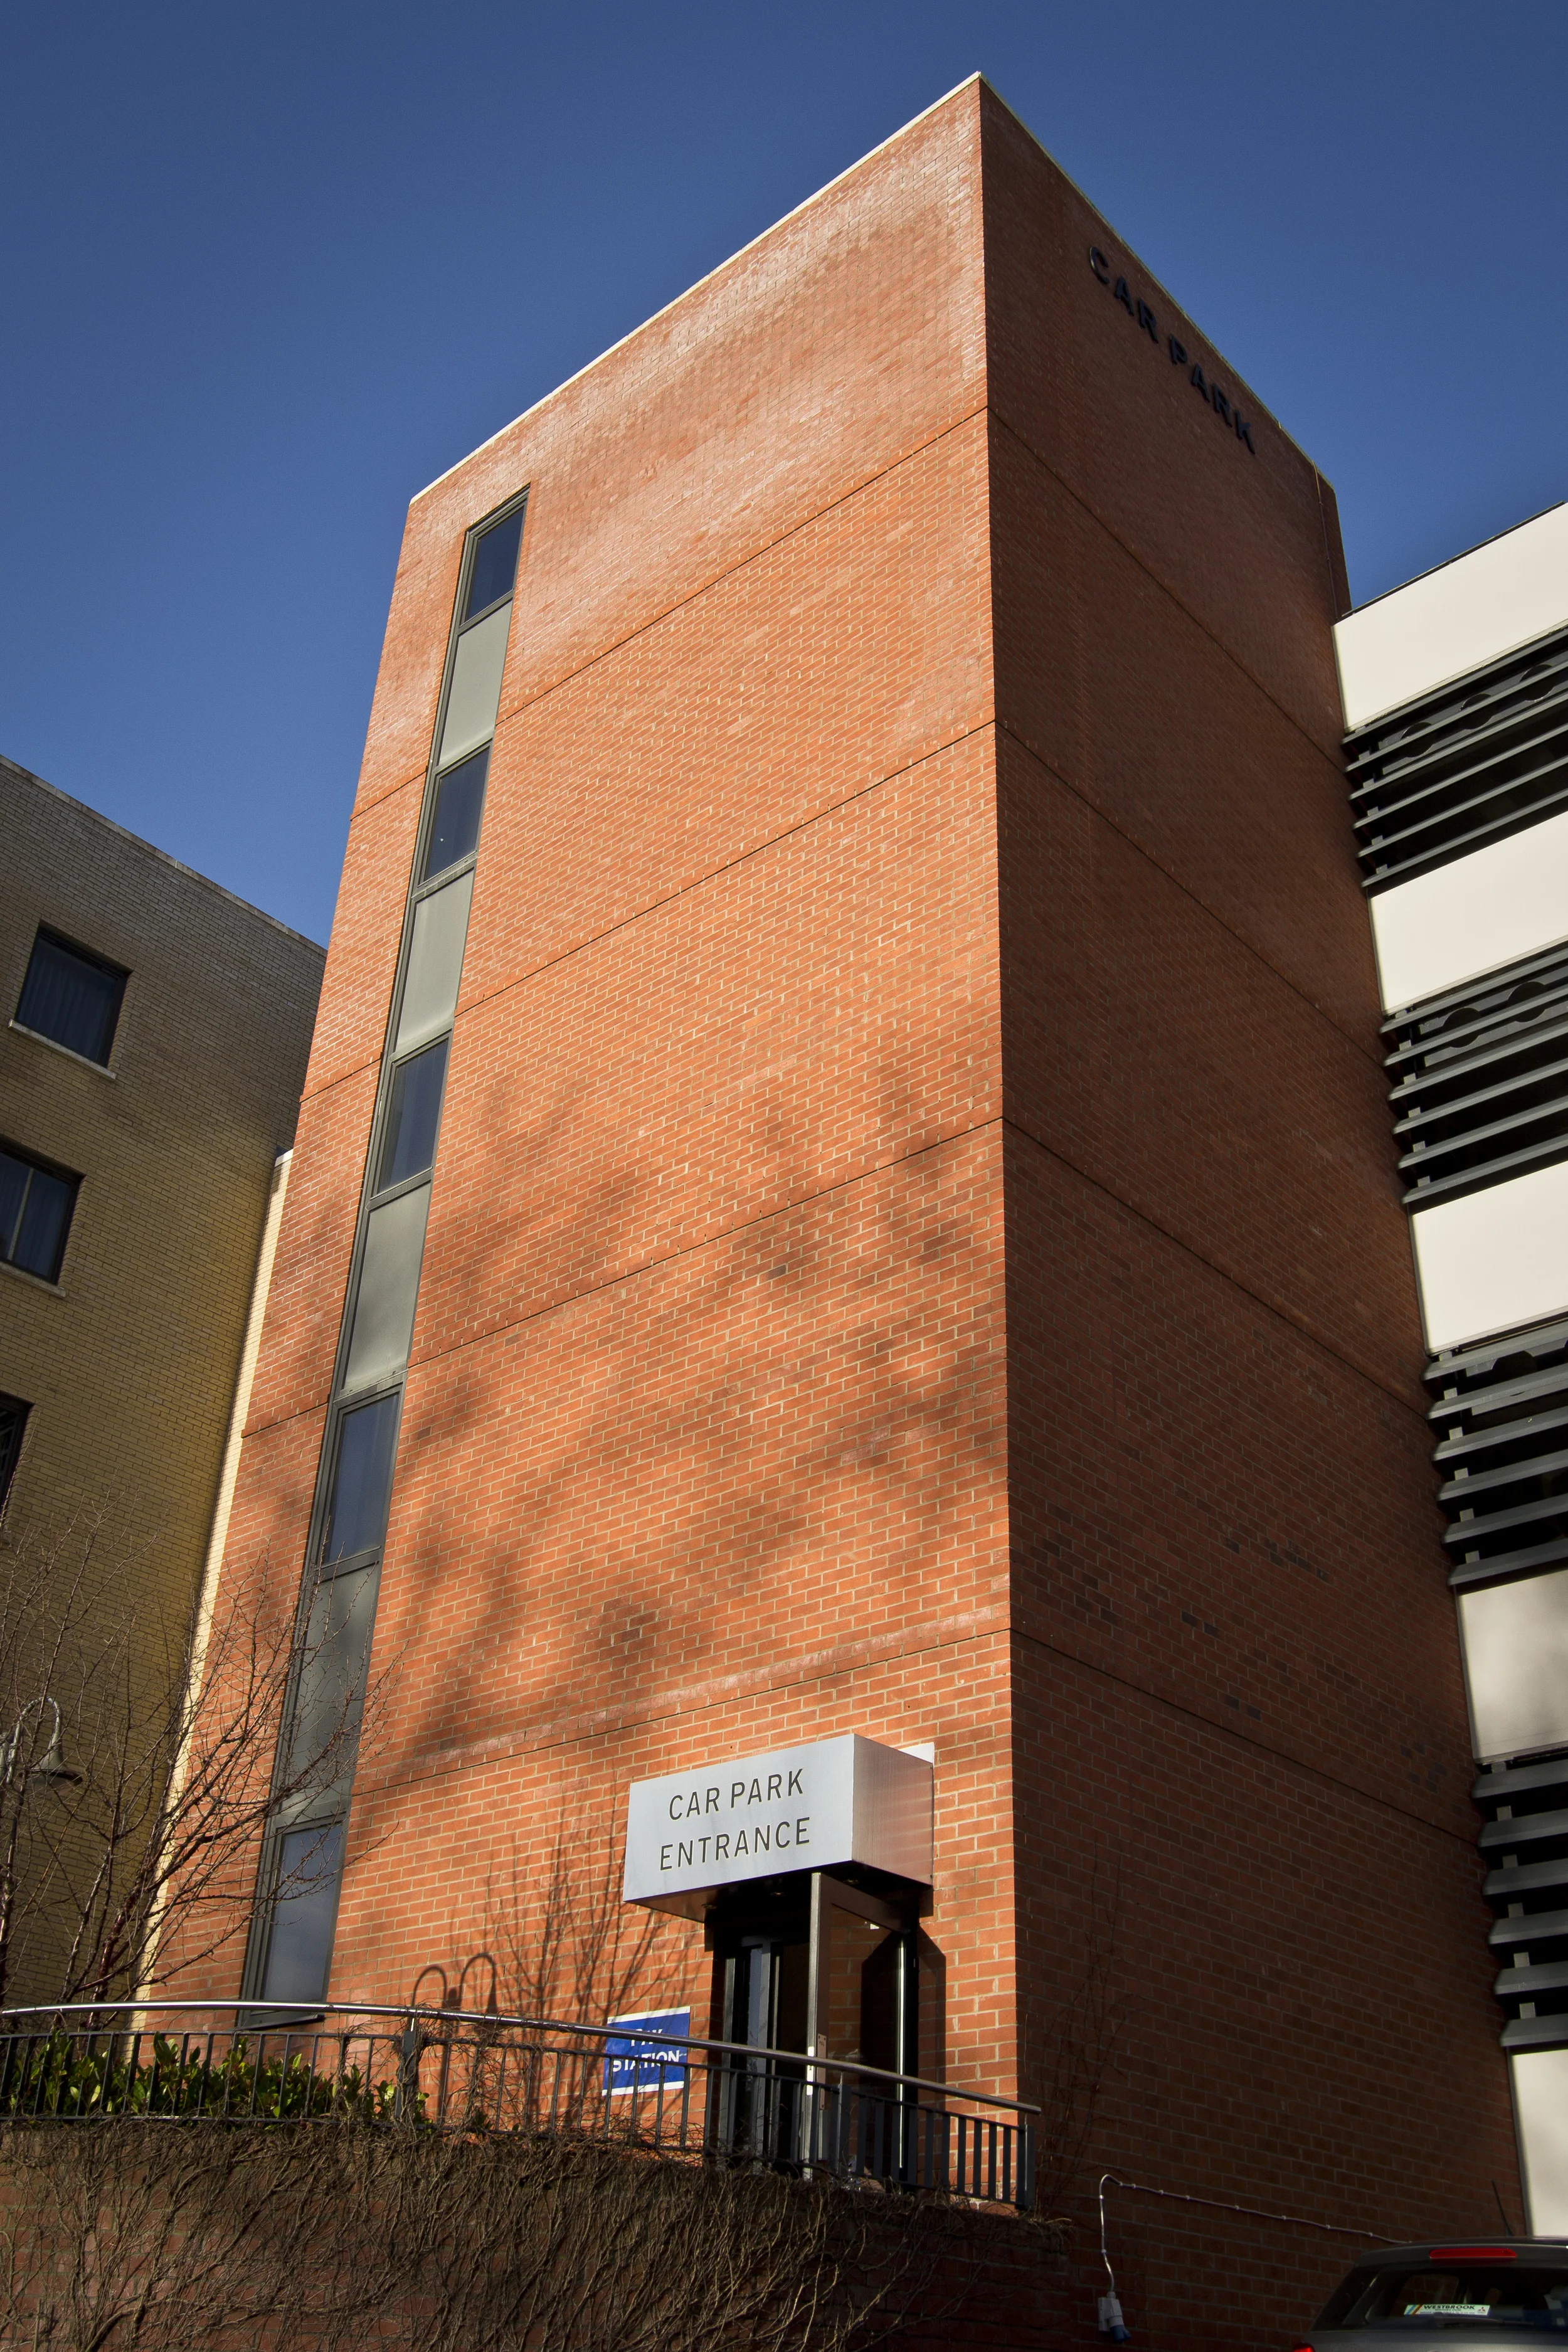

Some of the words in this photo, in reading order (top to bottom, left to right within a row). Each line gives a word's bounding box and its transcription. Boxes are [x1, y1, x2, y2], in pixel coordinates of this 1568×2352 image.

[1089, 246, 1159, 344] CAR
[1169, 334, 1255, 454] PARK
[669, 1788, 720, 1820] CAR
[731, 1768, 803, 1808] PARK
[660, 1816, 810, 1871] ENTRANCE
